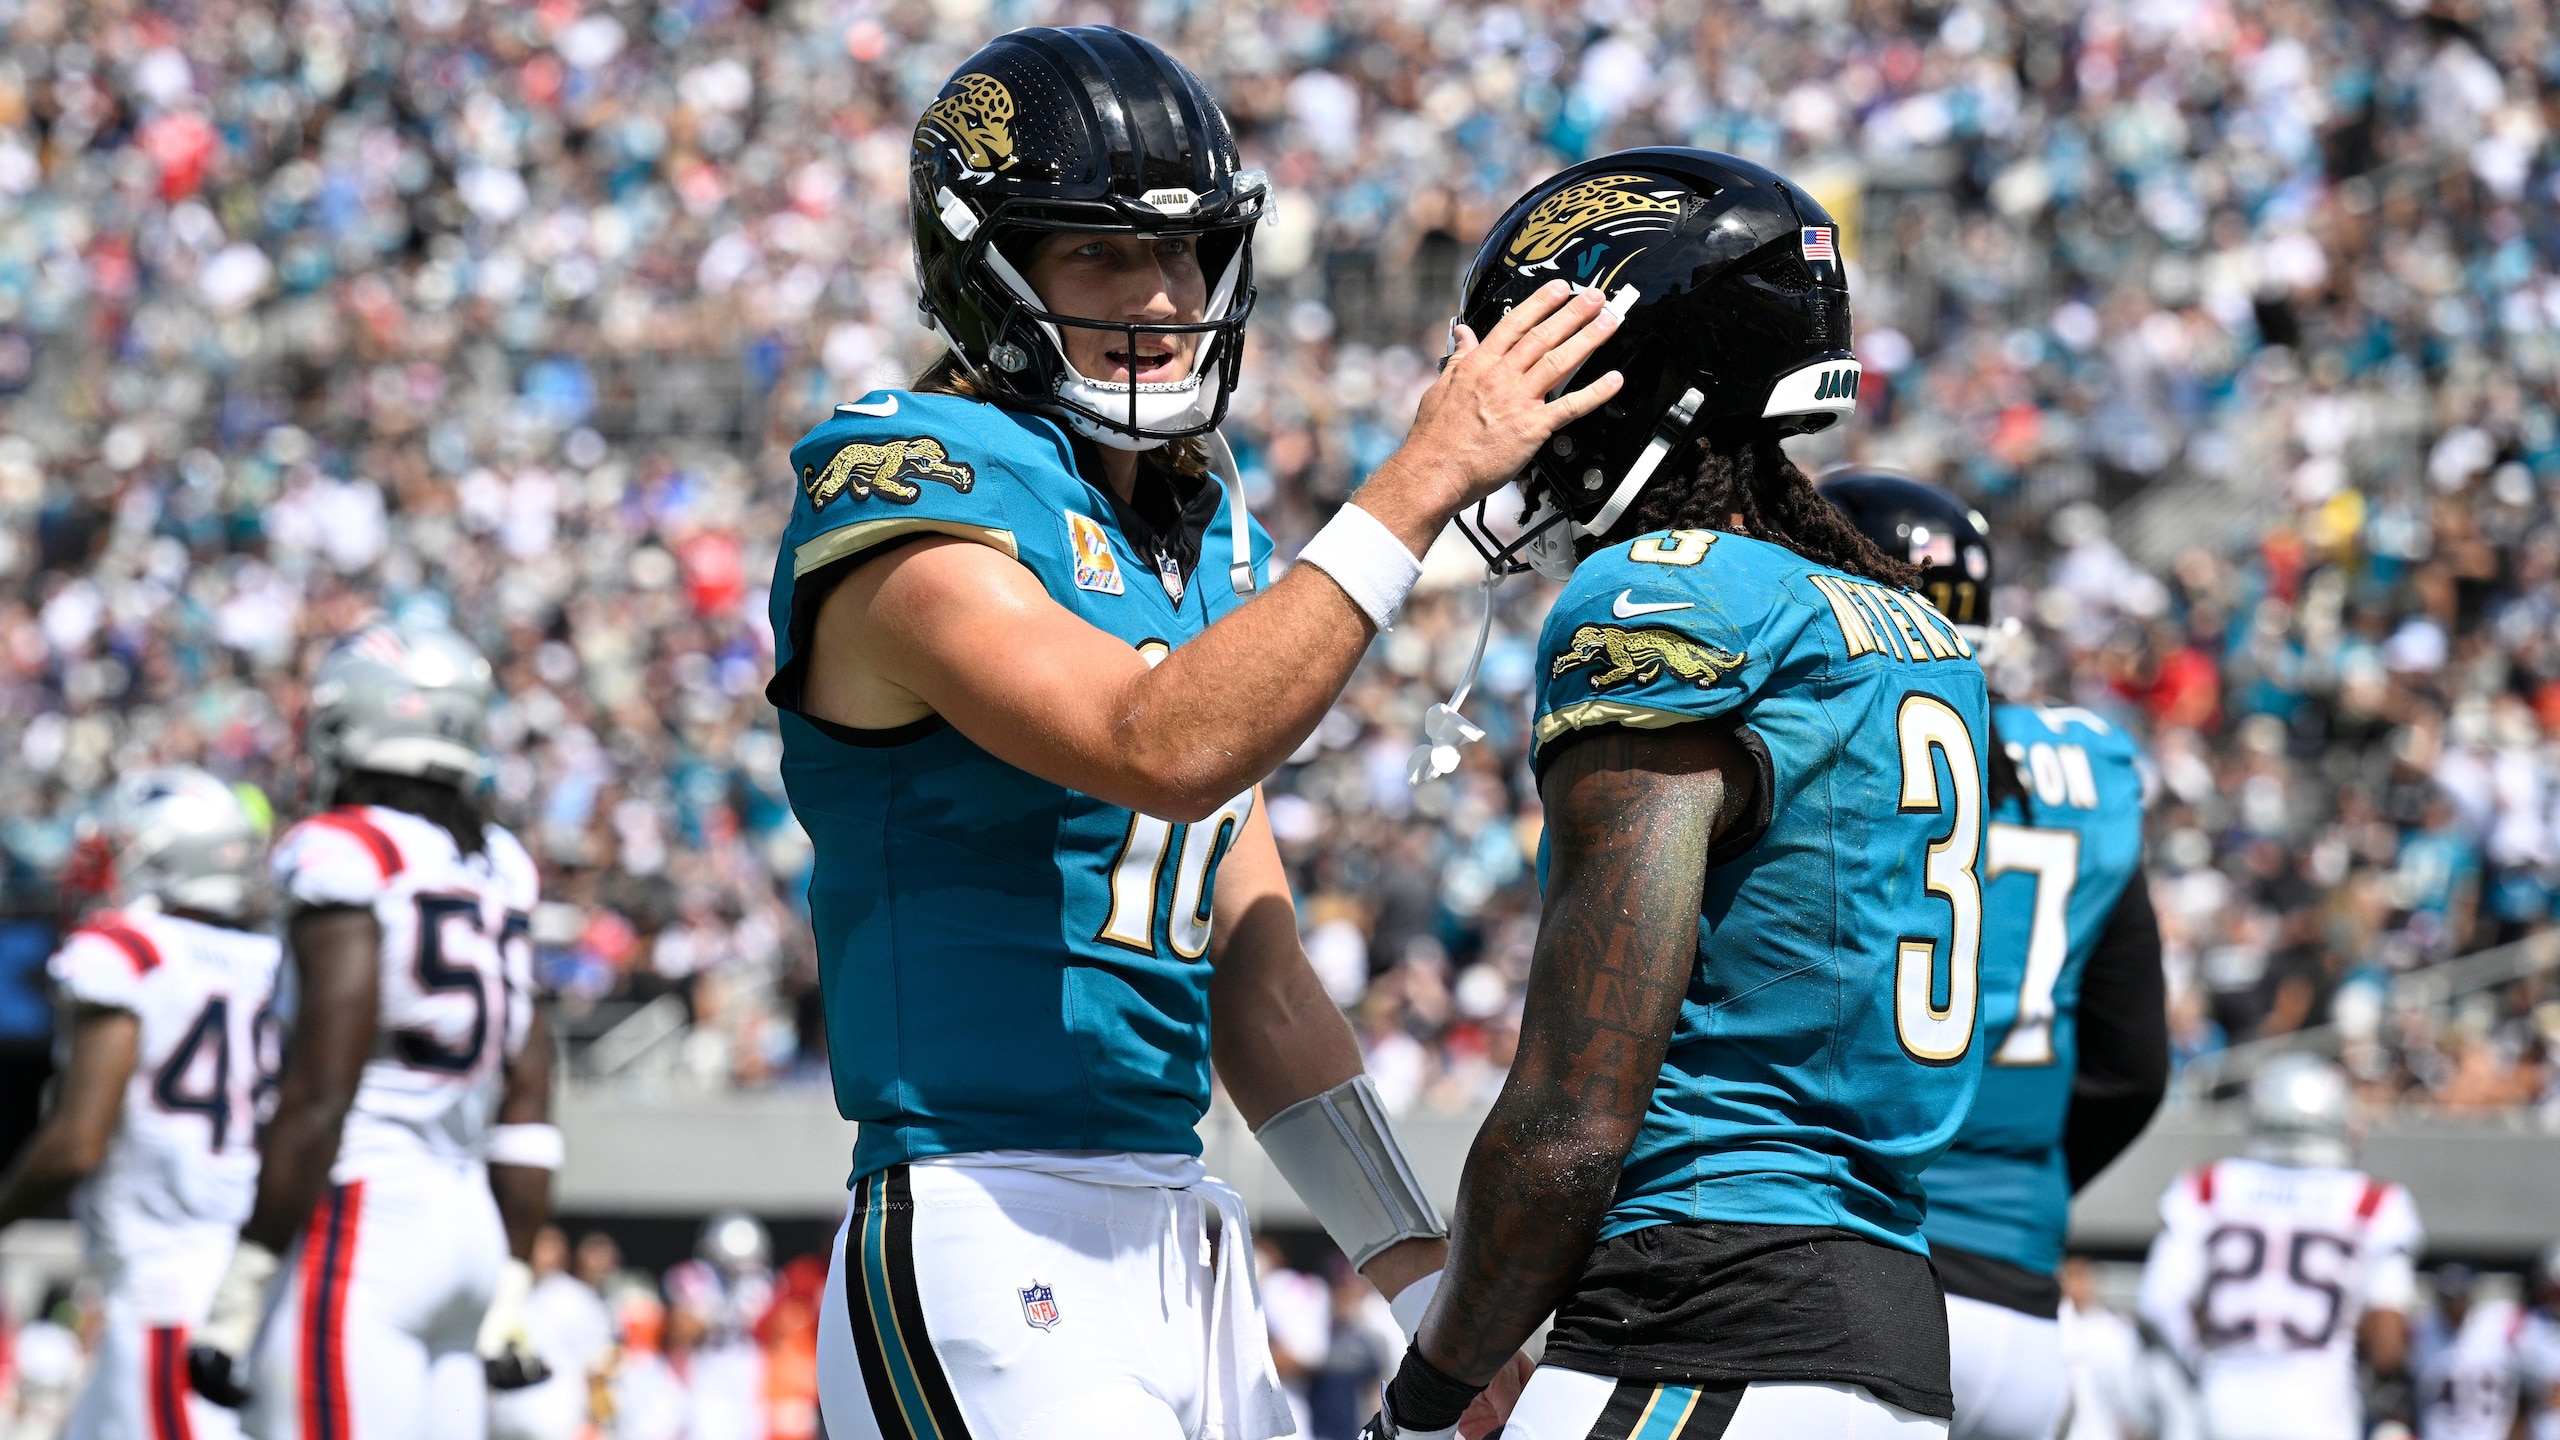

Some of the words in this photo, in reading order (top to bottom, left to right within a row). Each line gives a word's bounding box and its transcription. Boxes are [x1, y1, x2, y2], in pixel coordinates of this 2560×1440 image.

[1151, 194, 1189, 206] JAGUARS
[1627, 528, 1720, 568] 3
[1893, 689, 1983, 1068] 3
[2192, 1224, 2355, 1351] 25
[1029, 1301, 1057, 1322] NFL
